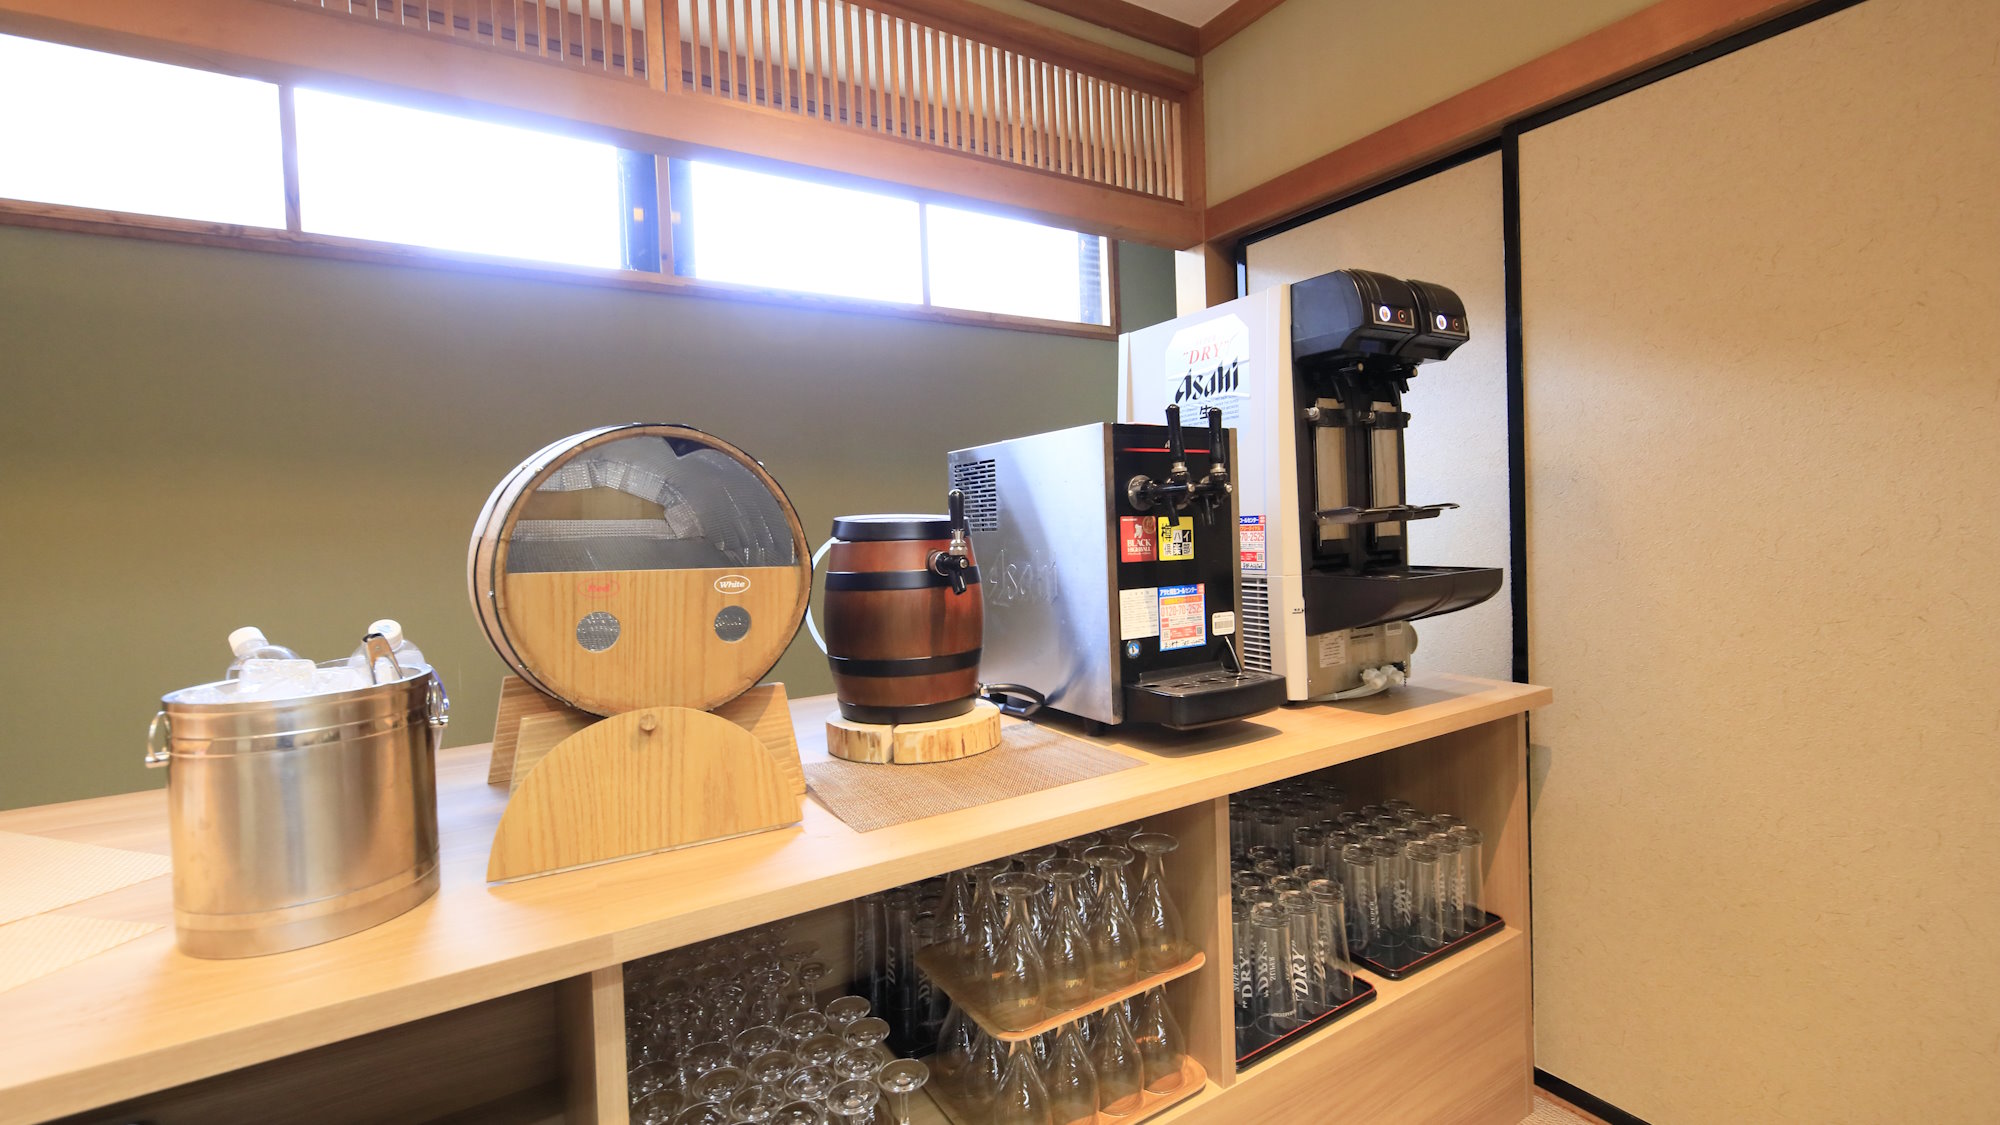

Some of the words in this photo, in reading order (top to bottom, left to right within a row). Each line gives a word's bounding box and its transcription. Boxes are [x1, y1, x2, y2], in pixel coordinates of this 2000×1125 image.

[1175, 355, 1239, 404] Asahi
[1127, 539, 1152, 547] BLACK
[587, 582, 610, 593] Red
[719, 580, 745, 589] White
